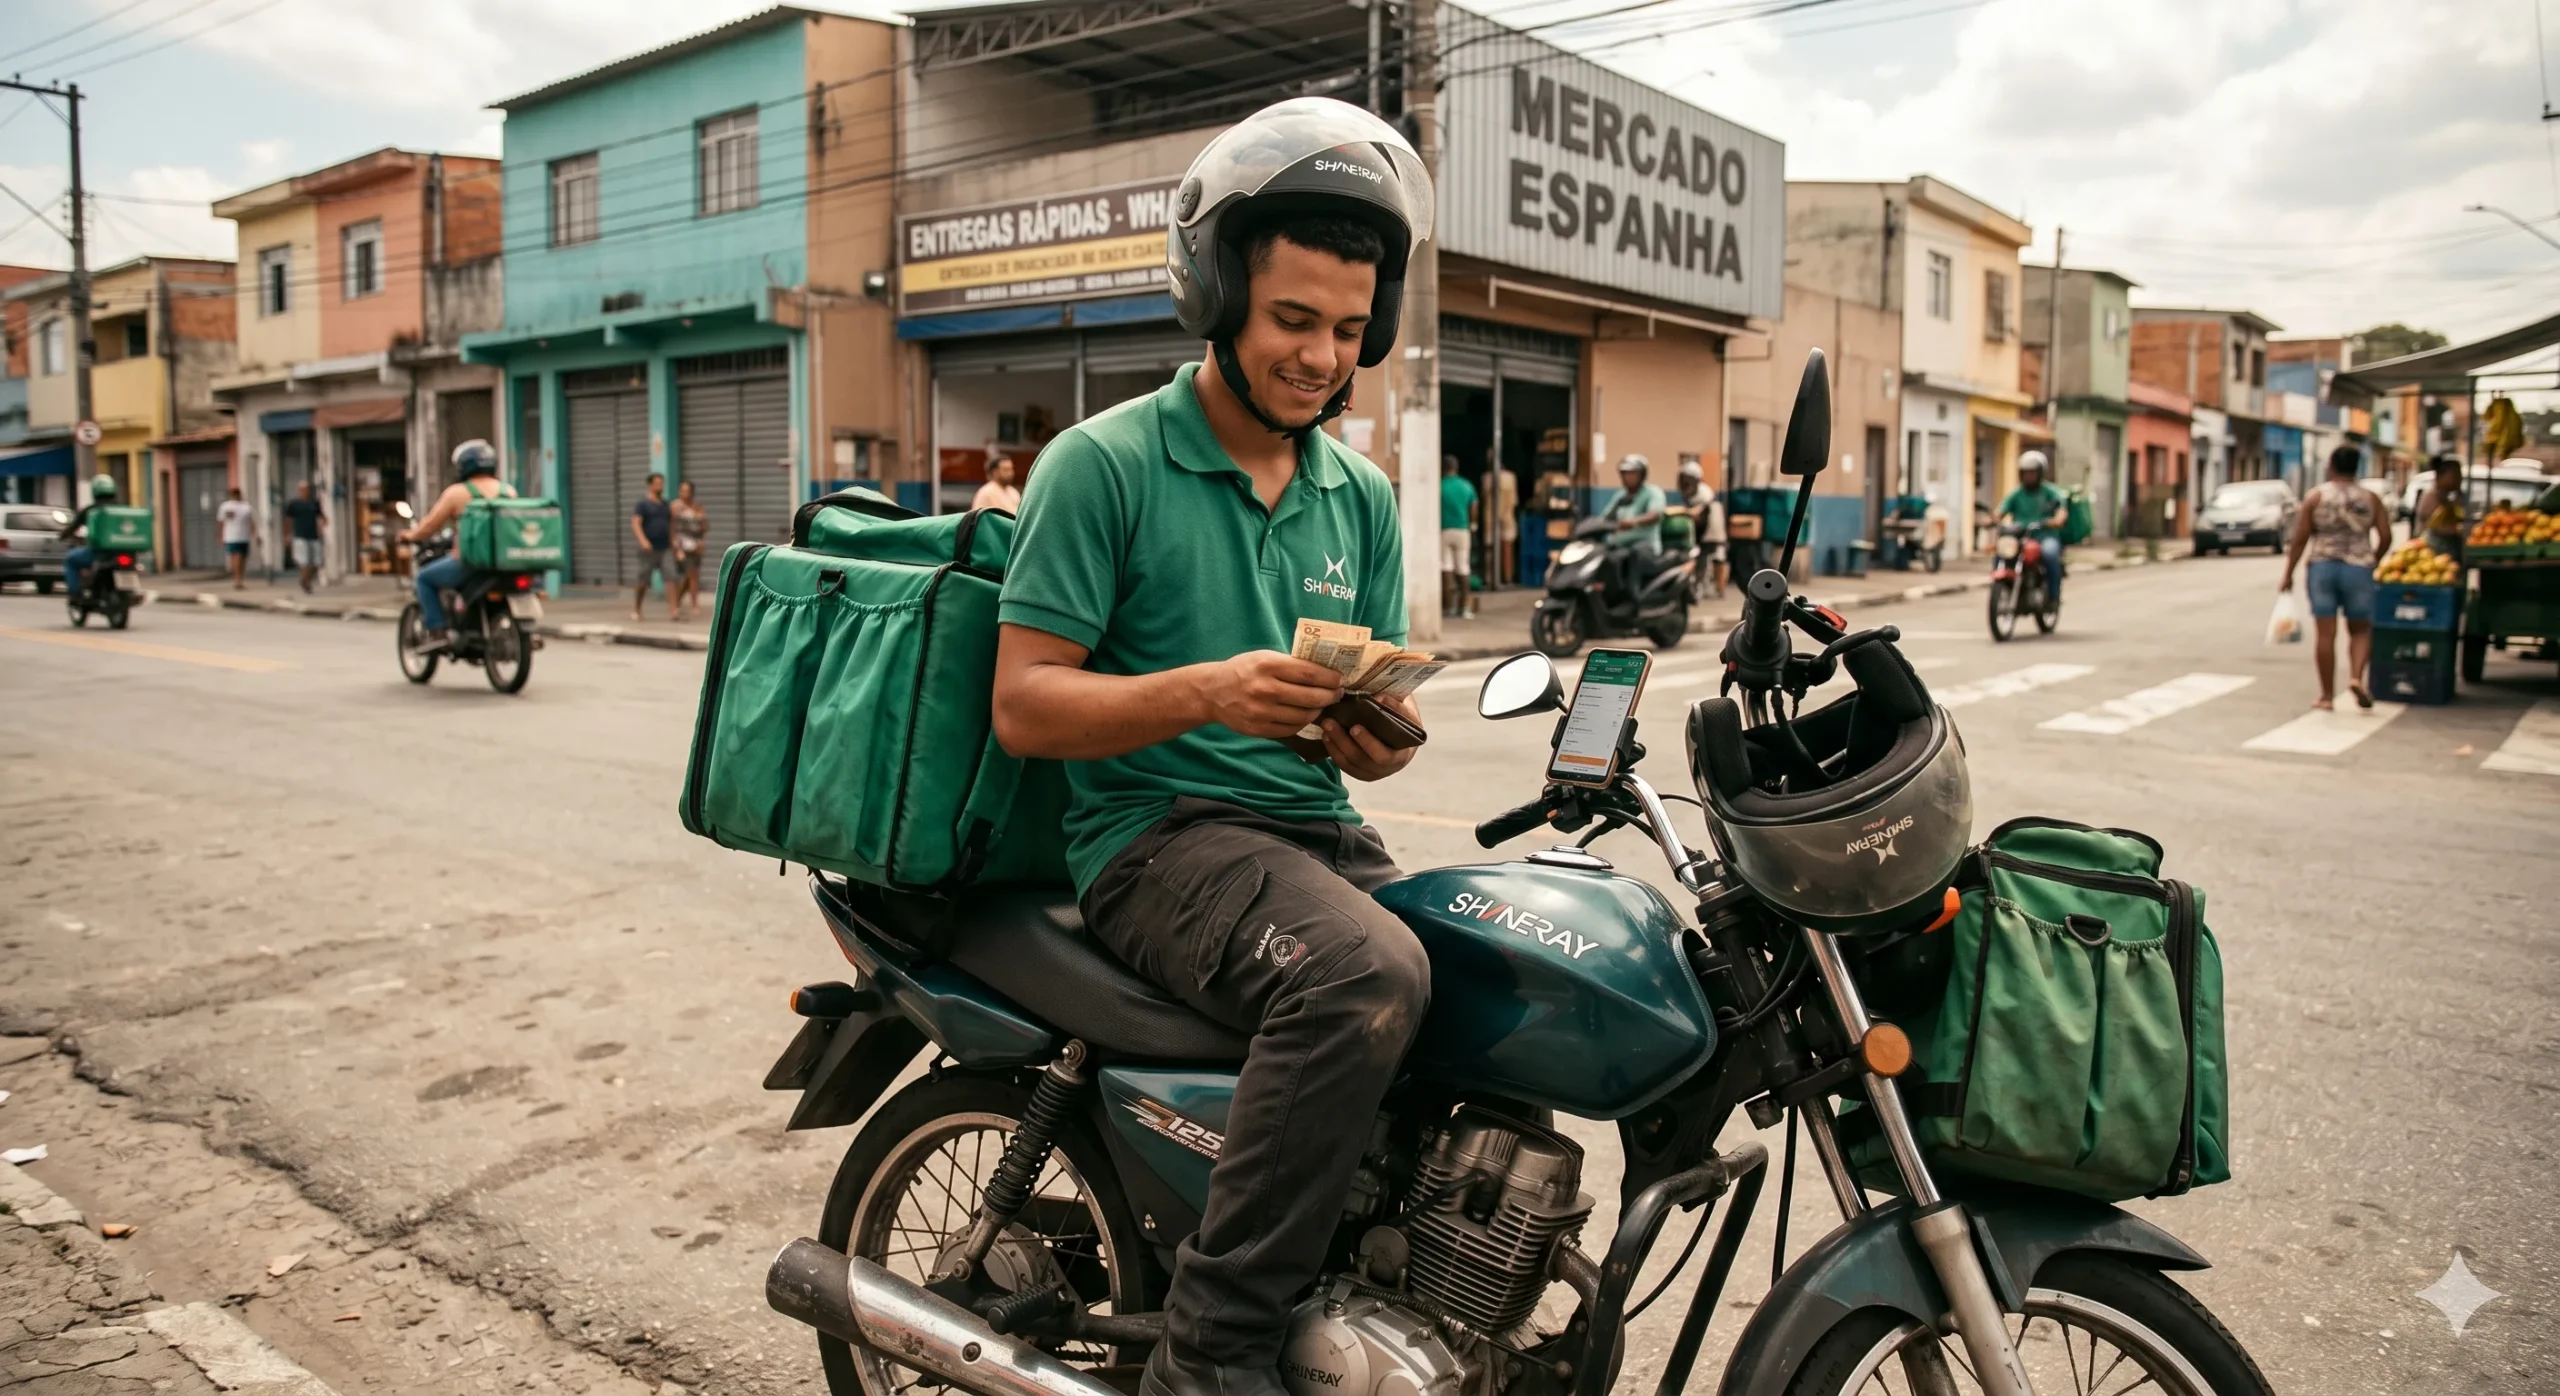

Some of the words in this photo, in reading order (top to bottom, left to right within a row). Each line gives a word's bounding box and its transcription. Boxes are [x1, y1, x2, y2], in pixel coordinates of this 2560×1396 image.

[1511, 65, 1745, 206] MERCADO
[910, 211, 1015, 258] ENTREGAS
[1018, 198, 1112, 244] RÁPIDAS
[1510, 157, 1743, 284] ESPANHA
[1167, 1116, 1225, 1151] 125
